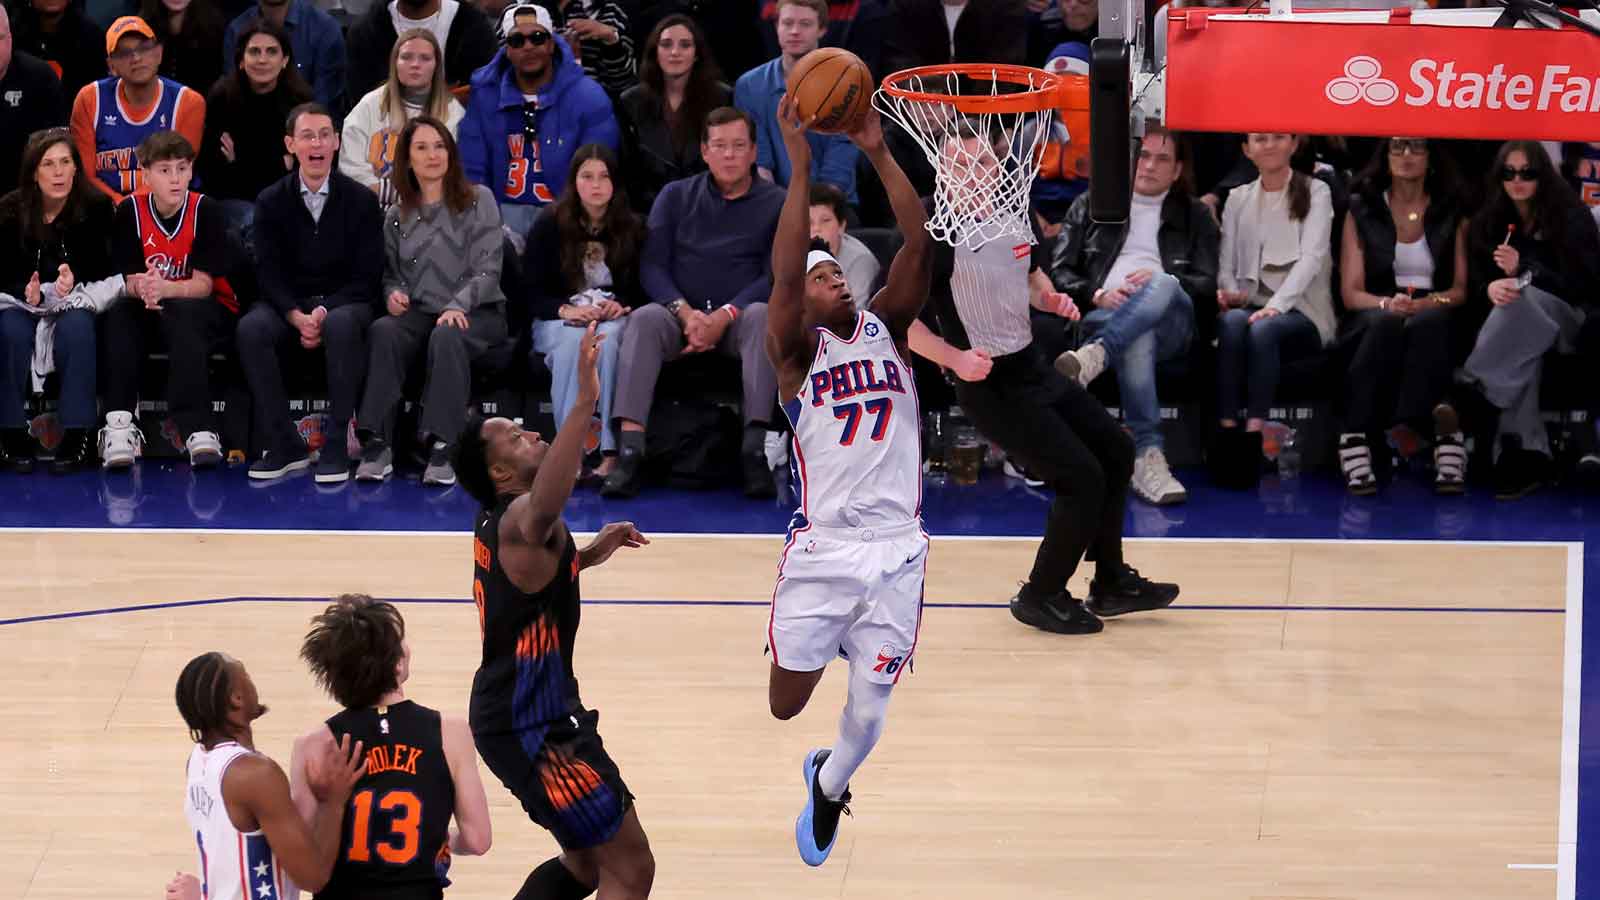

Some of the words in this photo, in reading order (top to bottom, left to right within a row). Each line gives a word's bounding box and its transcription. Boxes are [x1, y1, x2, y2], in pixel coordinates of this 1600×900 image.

[1404, 58, 1534, 111] State
[810, 359, 906, 408] PHILA
[832, 397, 894, 446] 77
[873, 655, 903, 674] 76
[347, 789, 423, 864] 13
